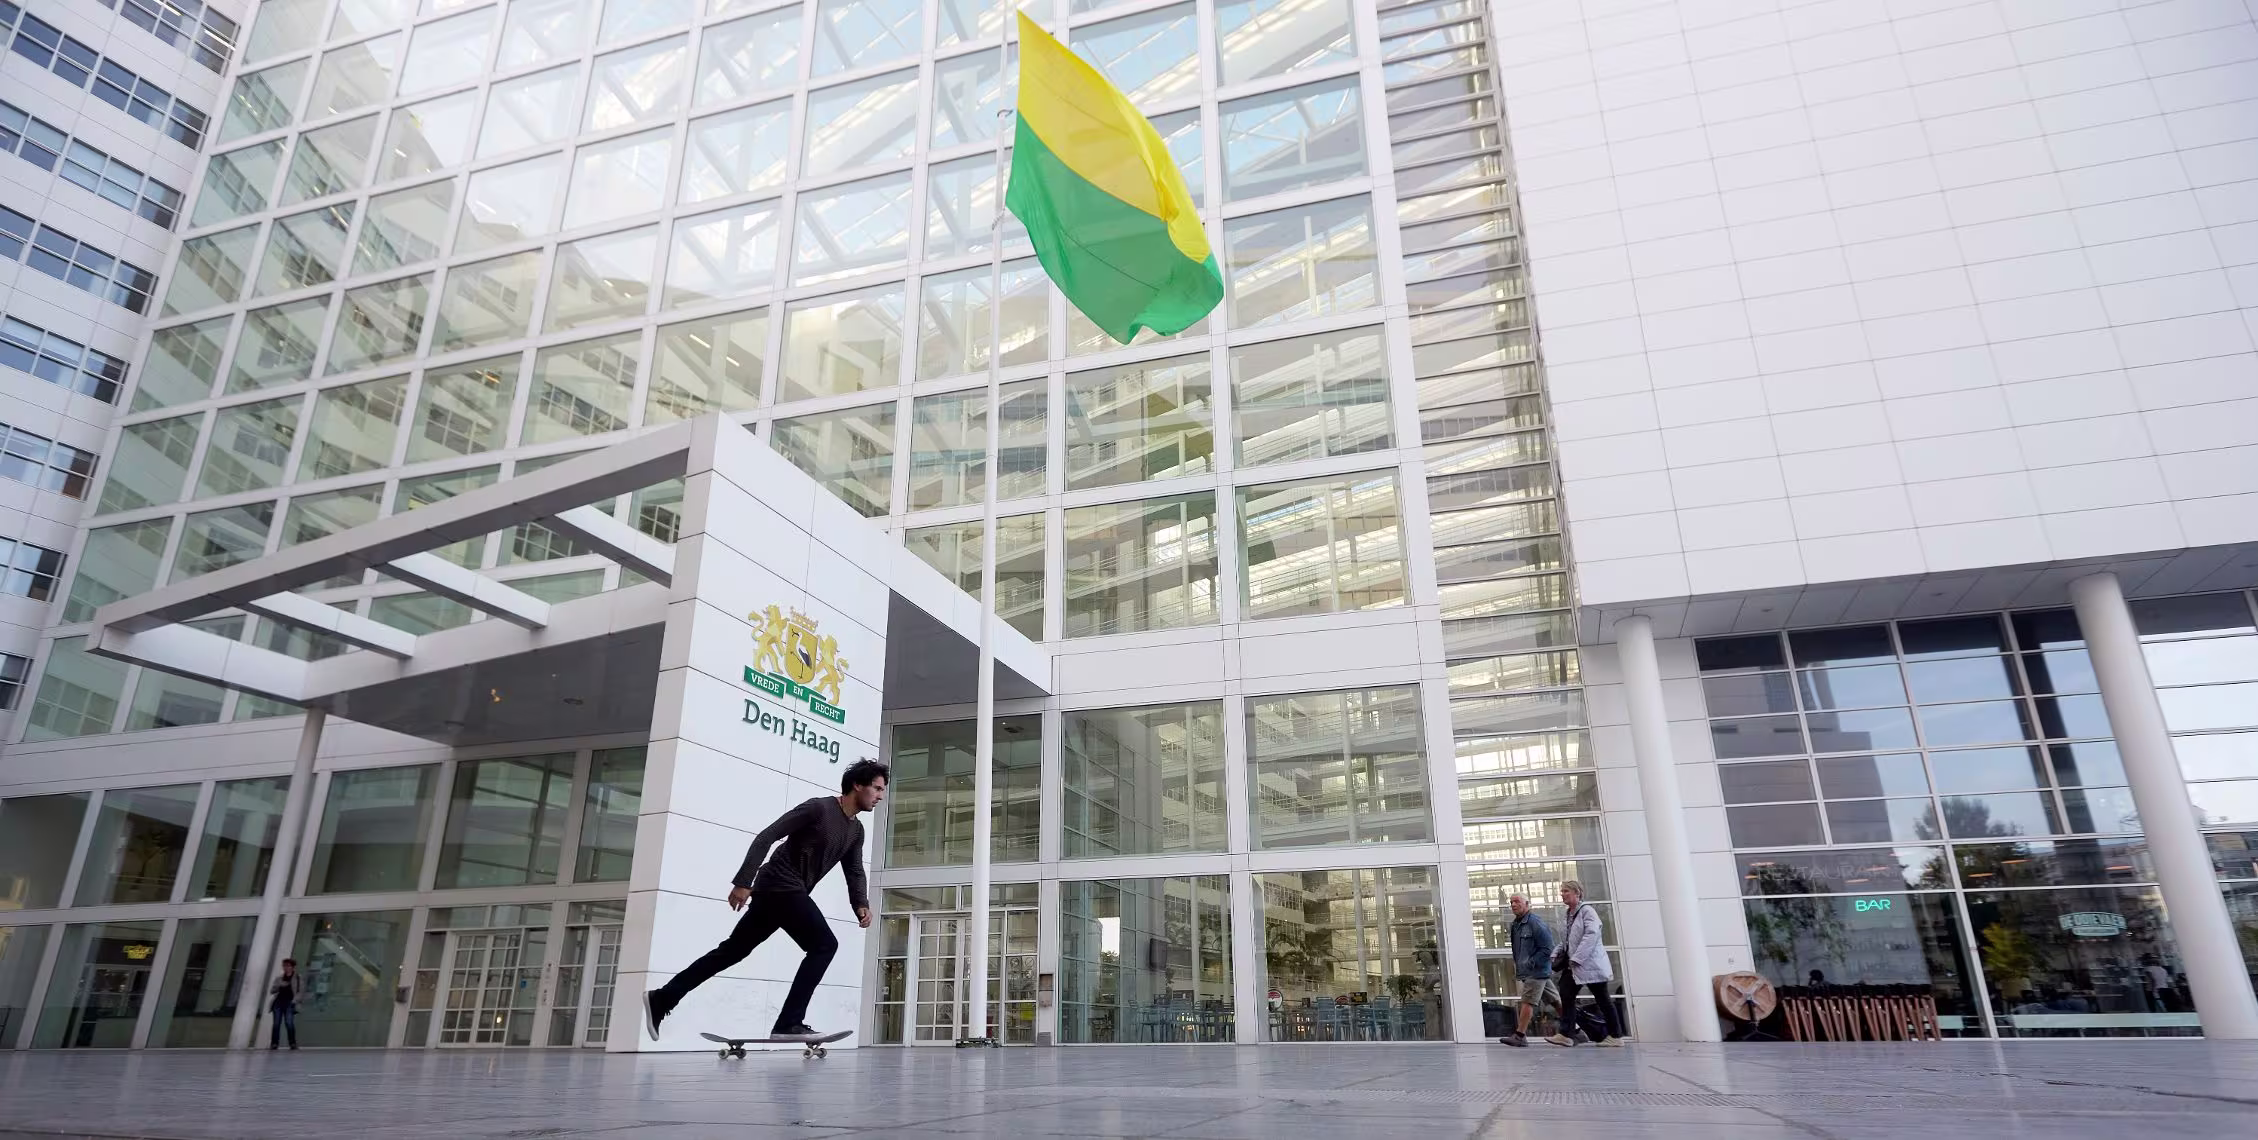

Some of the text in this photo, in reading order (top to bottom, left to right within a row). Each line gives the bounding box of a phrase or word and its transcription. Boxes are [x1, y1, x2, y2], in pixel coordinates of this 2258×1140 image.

[750, 672, 841, 720] VREDE EN RECHT
[742, 698, 841, 764] Den Haag
[1855, 899, 1891, 912] BAR
